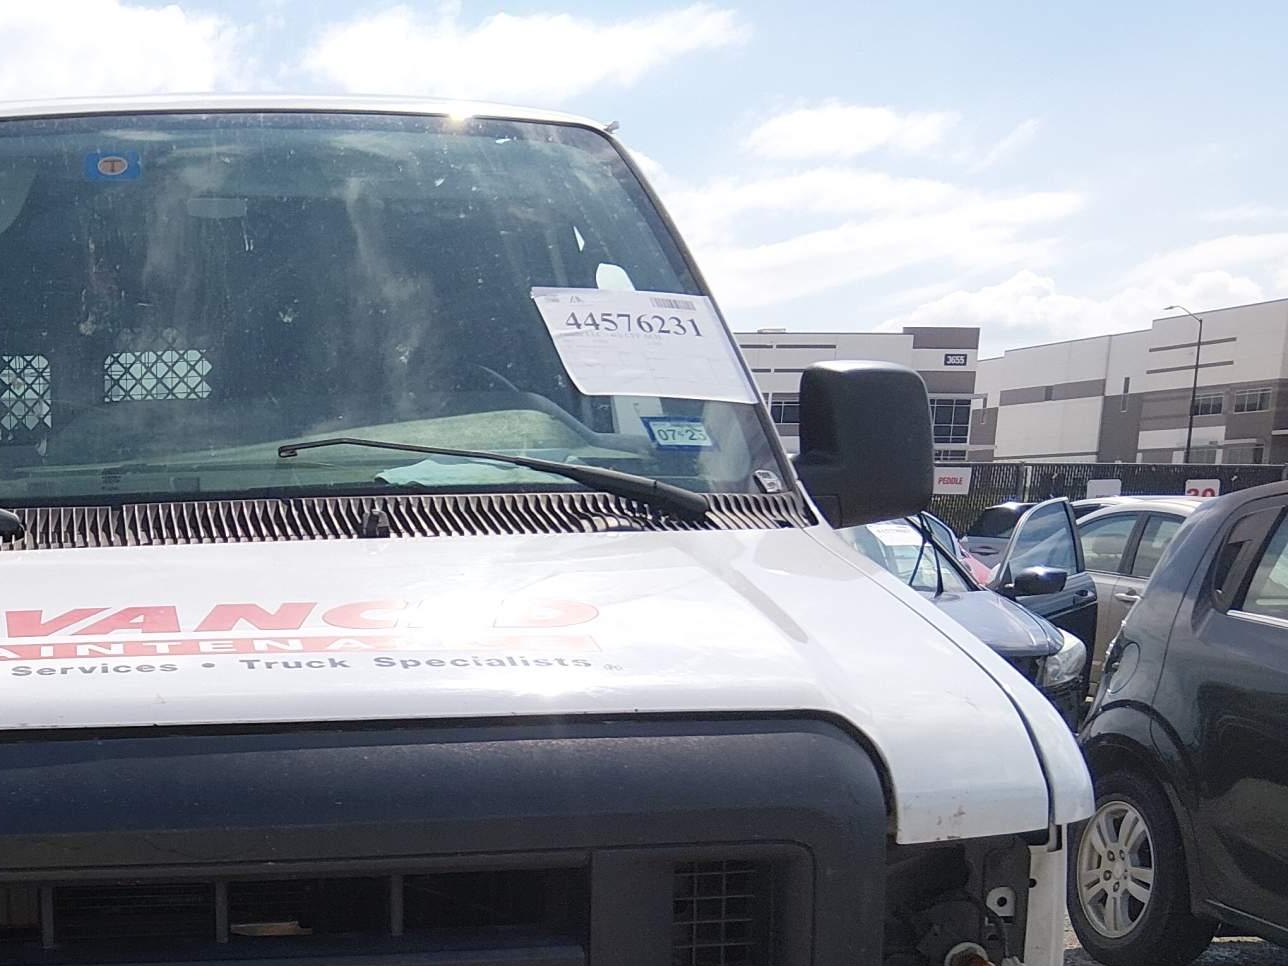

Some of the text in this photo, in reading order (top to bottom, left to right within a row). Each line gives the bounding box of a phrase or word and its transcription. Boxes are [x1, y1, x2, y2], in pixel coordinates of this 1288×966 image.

[565, 311, 703, 337] 44576231
[11, 661, 179, 677] Services
[239, 657, 350, 670] Truck
[373, 656, 593, 670] Specialists
